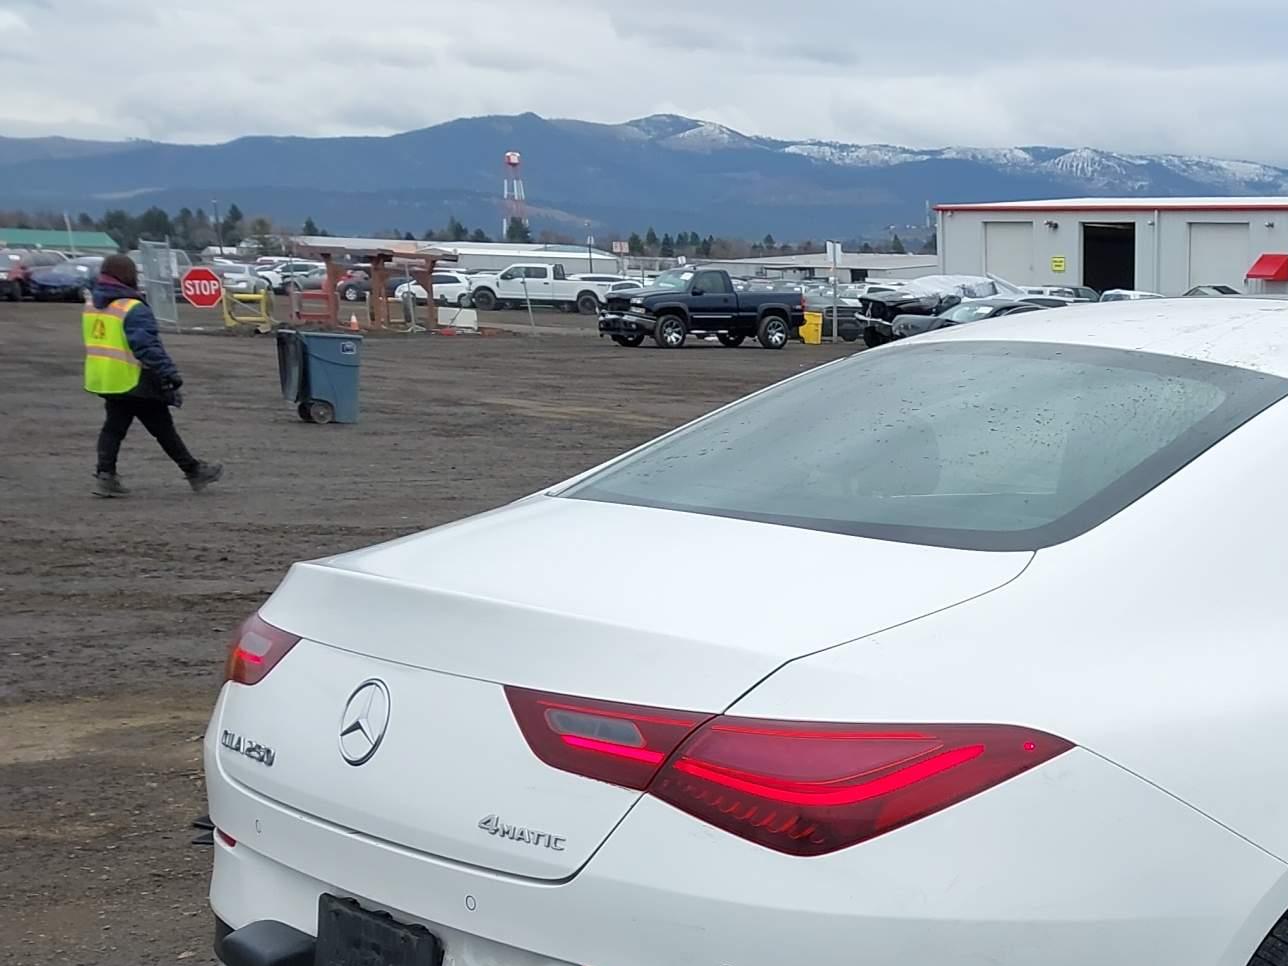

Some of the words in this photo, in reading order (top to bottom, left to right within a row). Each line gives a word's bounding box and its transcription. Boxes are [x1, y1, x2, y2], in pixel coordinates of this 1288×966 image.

[184, 279, 219, 296] STOP
[221, 729, 246, 755] CLA
[245, 740, 276, 767] 250
[477, 814, 567, 851] 4MATIC
